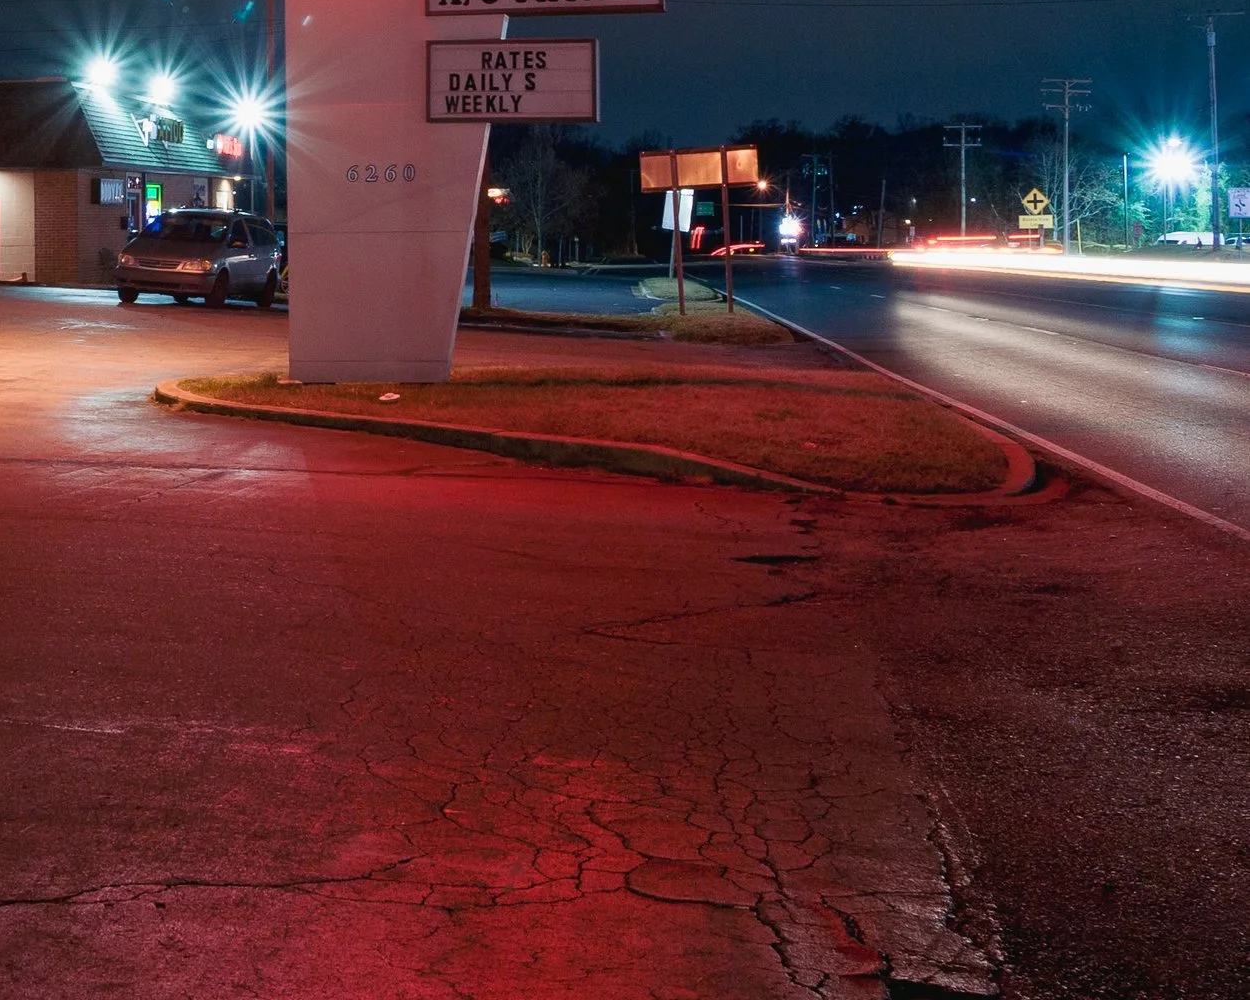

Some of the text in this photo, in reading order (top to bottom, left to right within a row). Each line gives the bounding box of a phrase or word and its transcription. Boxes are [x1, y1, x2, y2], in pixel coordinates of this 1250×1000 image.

[481, 51, 546, 70] RATES
[449, 72, 536, 92] DAILY S
[445, 95, 522, 113] WEEKLY
[346, 163, 416, 182] 6260
